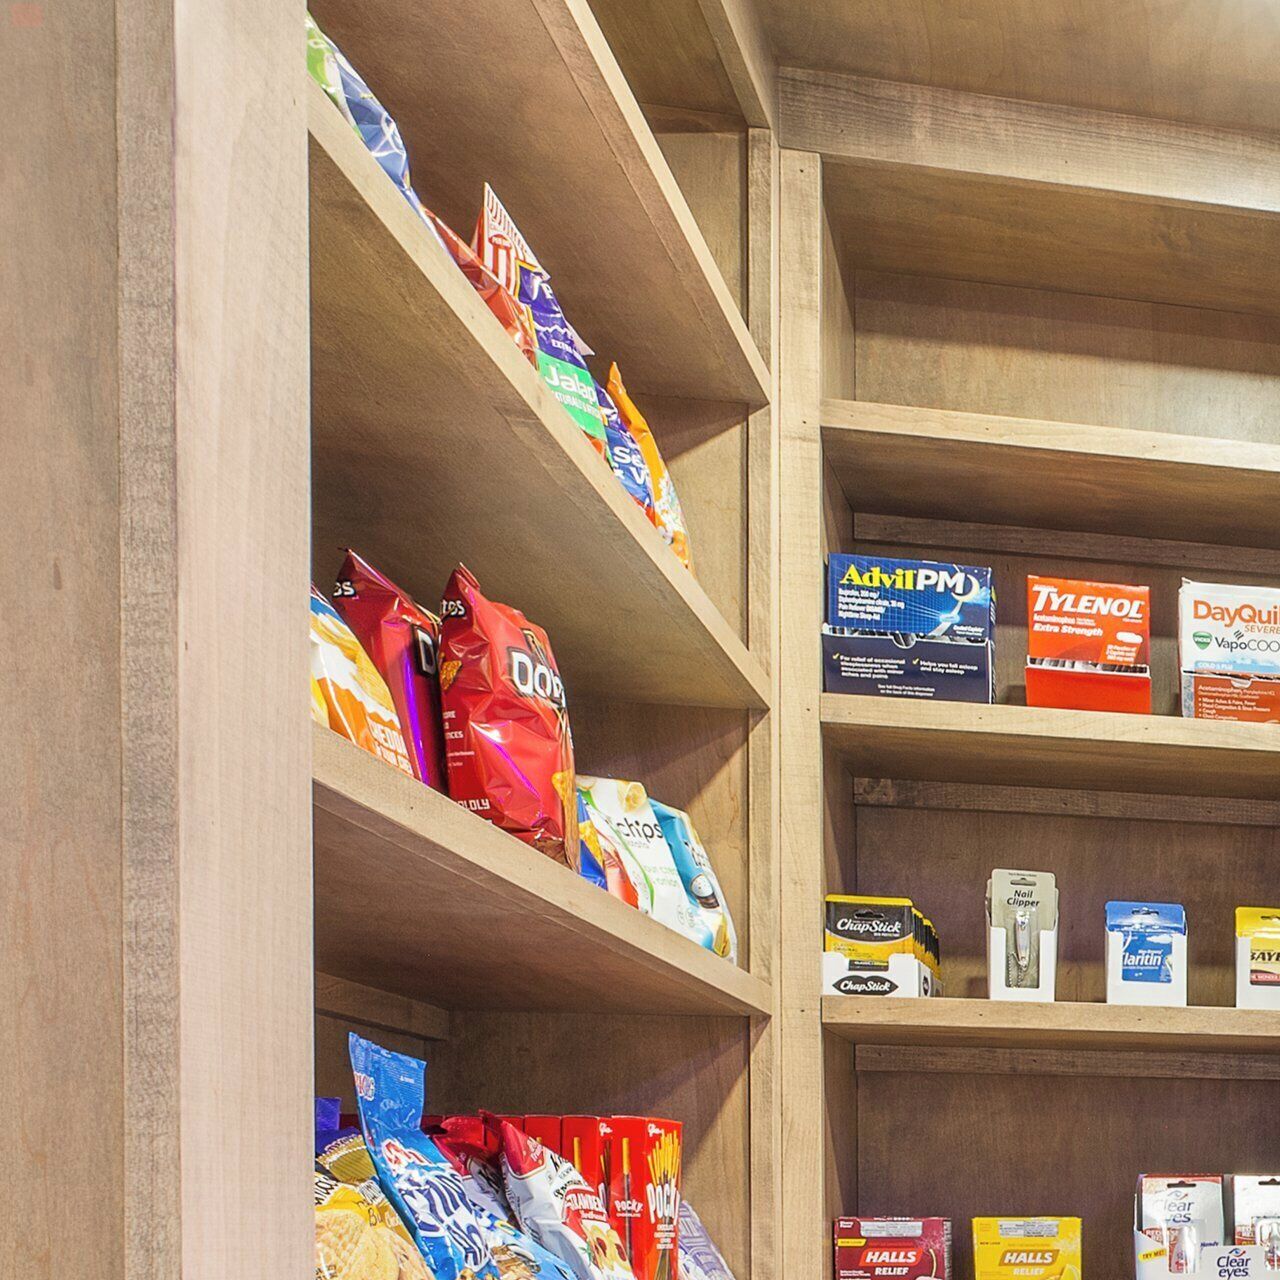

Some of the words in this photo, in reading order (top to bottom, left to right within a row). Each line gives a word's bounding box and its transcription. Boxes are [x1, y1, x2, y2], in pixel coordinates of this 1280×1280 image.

[840, 564, 914, 590] Advil
[916, 568, 966, 594] PM
[1032, 586, 1145, 618] TYLENOL
[1033, 624, 1059, 633] Extra
[1061, 625, 1103, 636] Strength
[1244, 625, 1280, 635] SEVERE
[1013, 890, 1033, 898] Nail
[1007, 897, 1040, 908] Clipper
[836, 917, 901, 934] ChapStick
[840, 980, 891, 992] ChapStick
[866, 1251, 917, 1263] HALLS
[1004, 1251, 1052, 1264] HALLS
[1217, 1256, 1251, 1270] Clear
[875, 1267, 909, 1276] RELIEF
[1013, 1267, 1045, 1276] RELIEF
[1218, 1267, 1250, 1280] eyes
